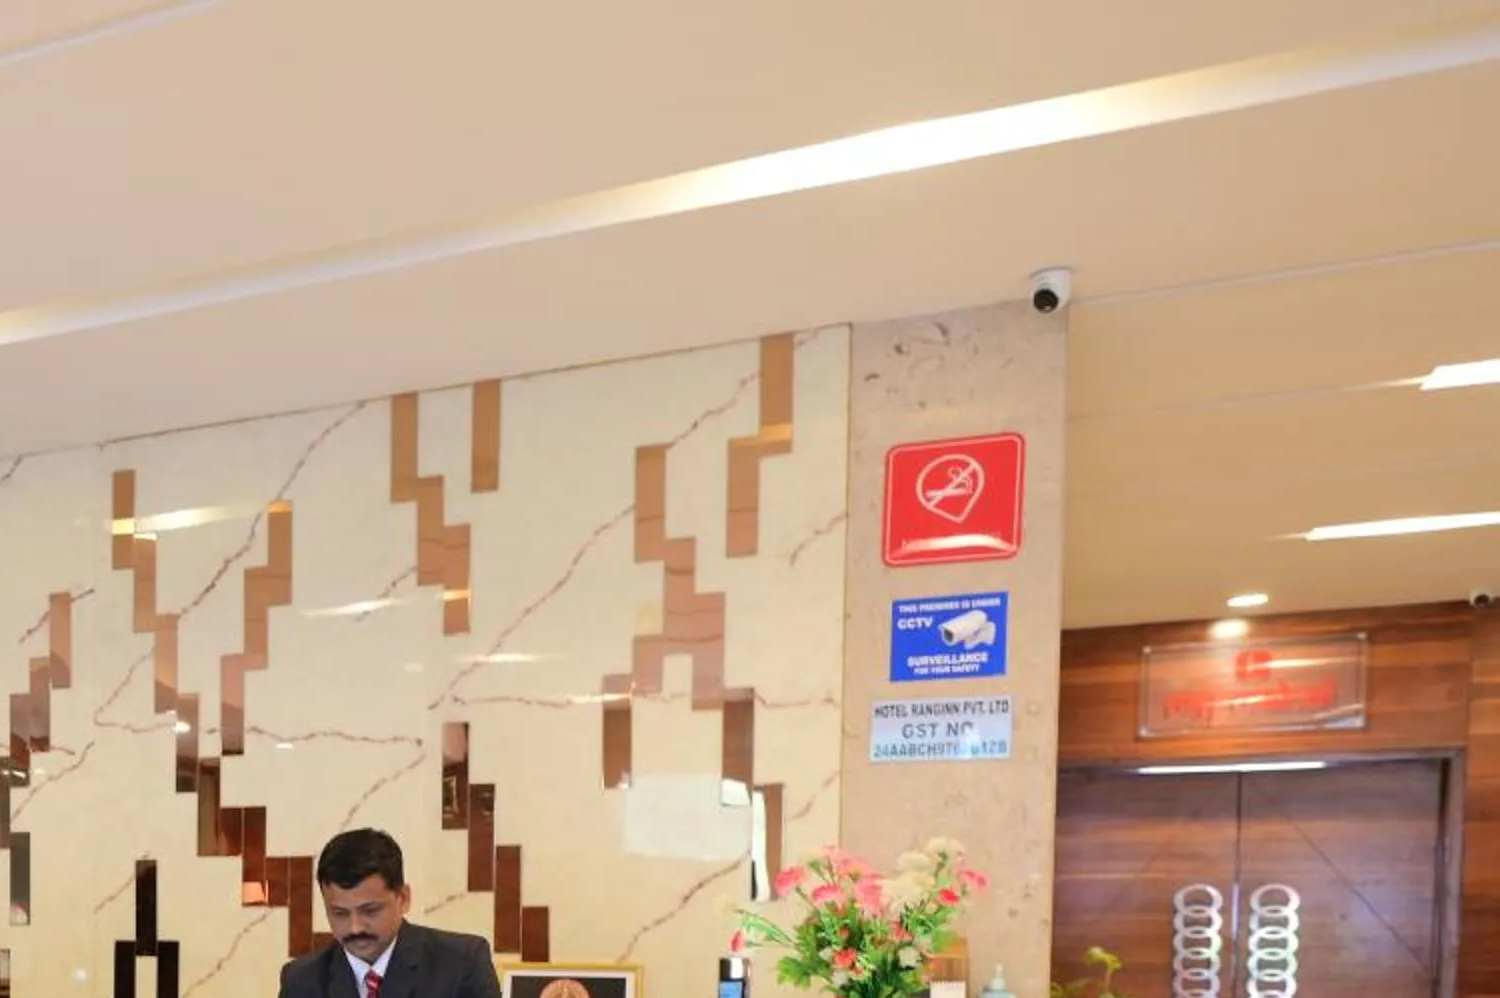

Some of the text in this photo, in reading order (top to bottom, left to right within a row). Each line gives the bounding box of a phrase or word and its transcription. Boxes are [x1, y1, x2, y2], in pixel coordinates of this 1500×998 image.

[972, 598, 1001, 608] UNDER
[897, 616, 933, 630] CCTV
[907, 651, 989, 668] SURVEILLANCE
[914, 666, 930, 675] FOR
[951, 663, 981, 674] SAFETY
[874, 704, 906, 719] HOTEL
[989, 699, 1009, 714] LTD
[902, 722, 940, 739] GST
